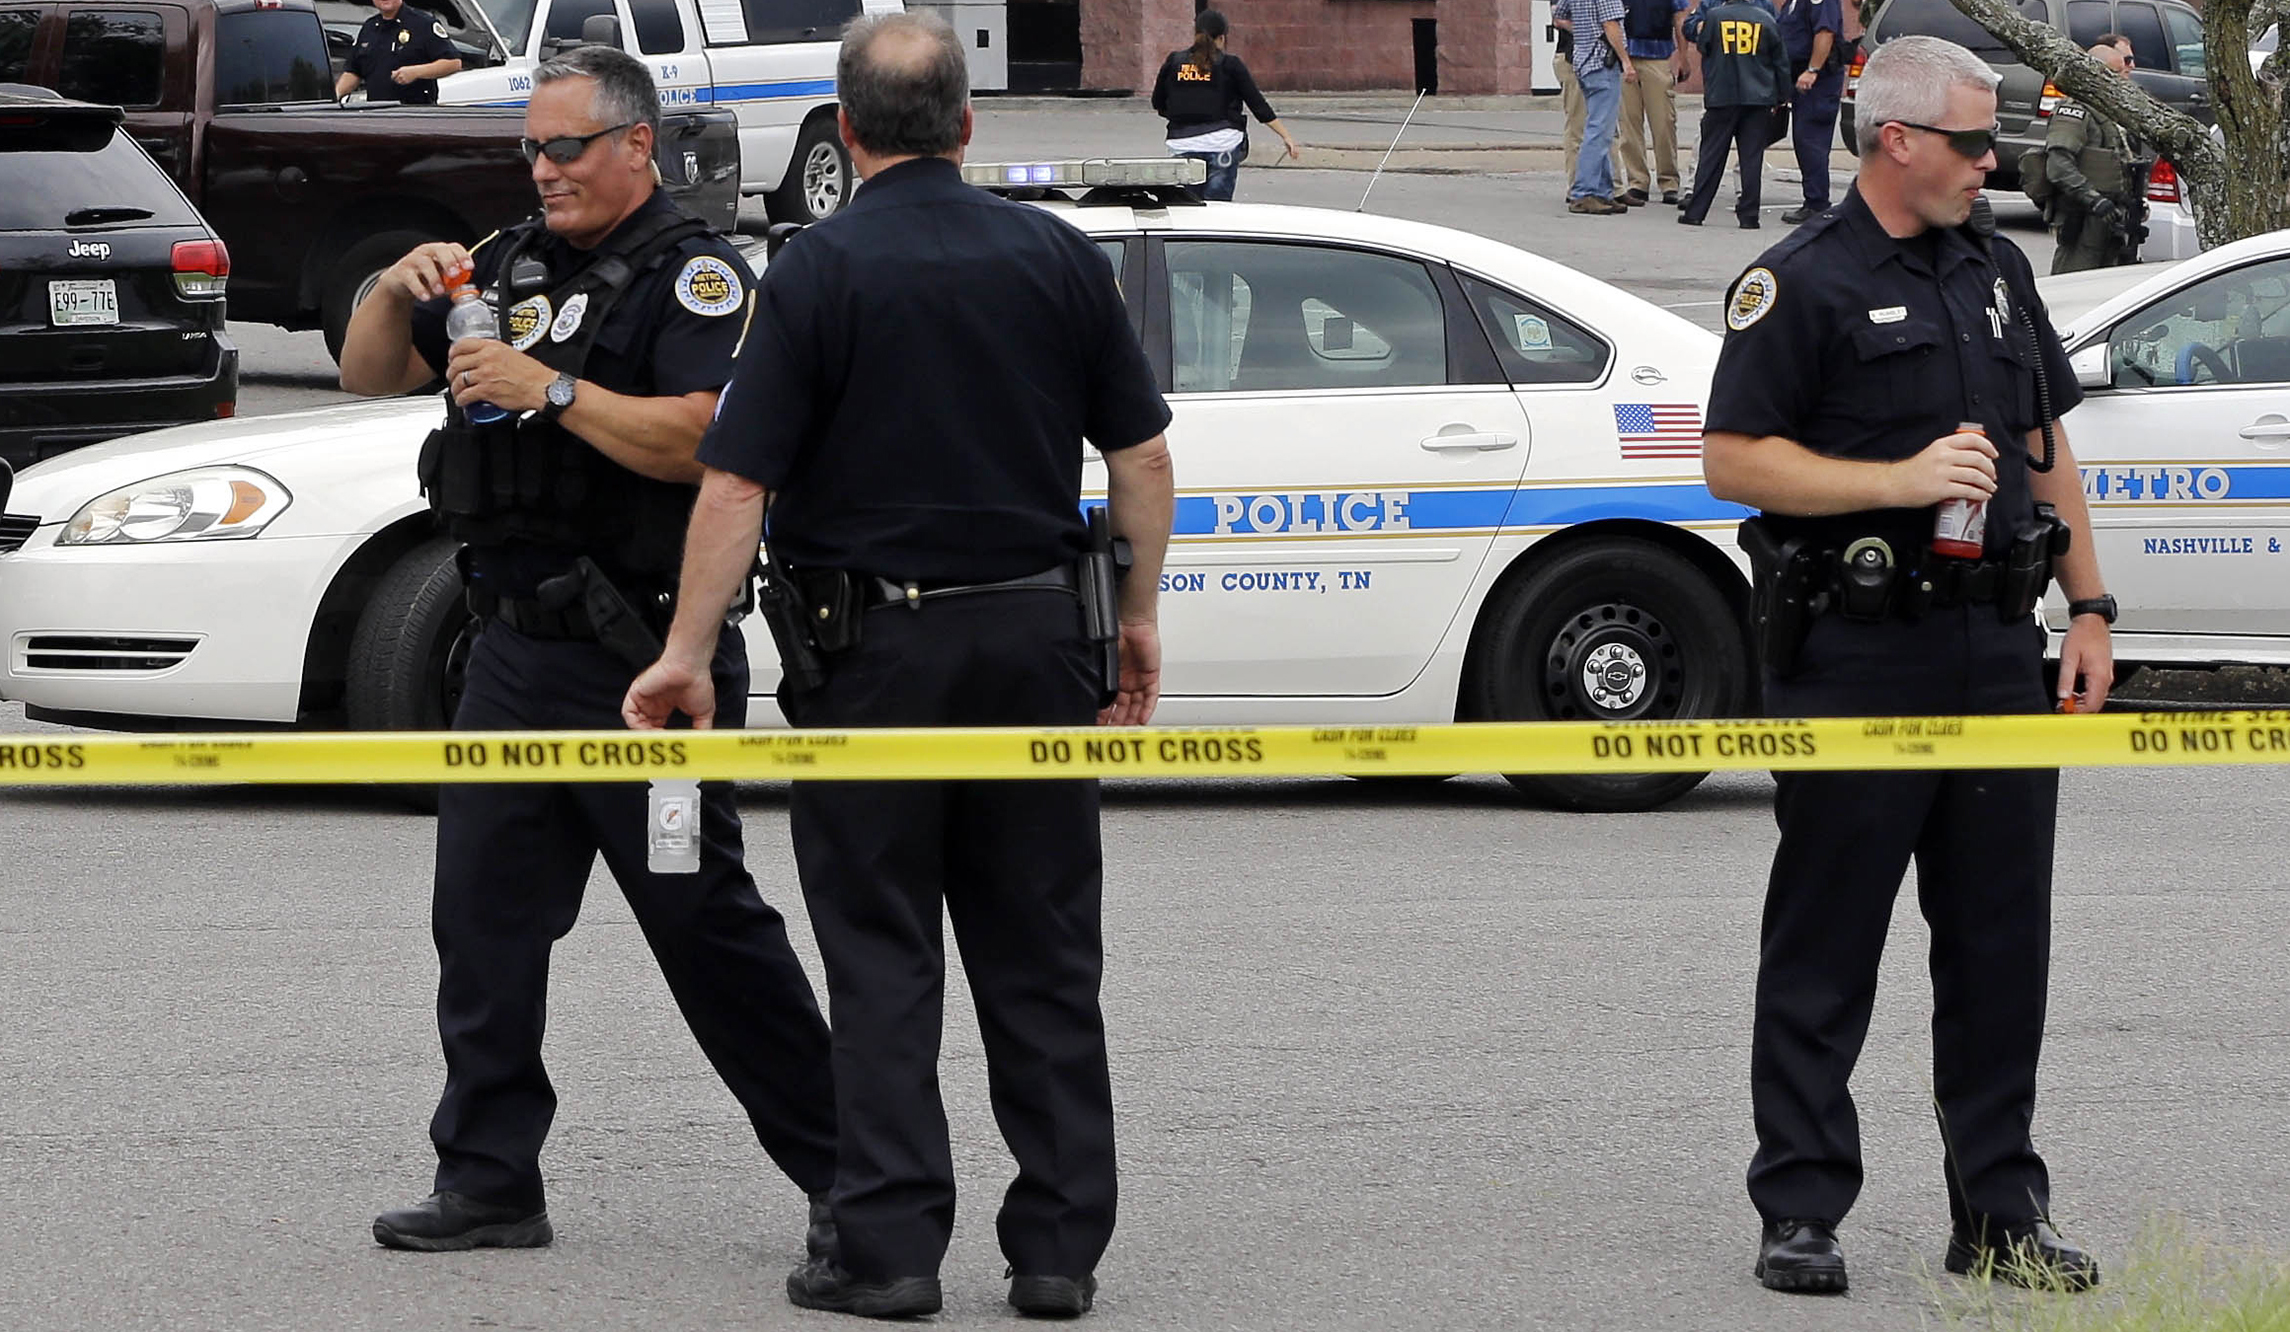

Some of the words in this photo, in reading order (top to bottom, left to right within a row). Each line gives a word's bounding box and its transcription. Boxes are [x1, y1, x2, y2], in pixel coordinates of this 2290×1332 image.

[1720, 21, 1761, 55] FBI
[660, 65, 679, 79] K-9
[508, 76, 531, 91] 1062
[2058, 107, 2085, 119] POLICE
[68, 240, 111, 260] Jeep
[691, 281, 729, 295] POLICE
[55, 291, 115, 312] E99-77E
[1213, 492, 1410, 534] POLICE
[2143, 537, 2253, 554] NASHVILLE
[2268, 536, 2281, 553] &
[1221, 571, 1326, 594] COUNTY,
[1338, 571, 1371, 590] TN
[1031, 740, 1071, 763] DO
[1086, 740, 1145, 763] NOT
[1160, 739, 1263, 763] CROSS
[1593, 735, 1633, 758] DO
[1646, 735, 1703, 757] NOT
[1716, 733, 1816, 757] CROSS
[2130, 729, 2168, 752] DO
[2181, 729, 2235, 752] NOT
[444, 743, 487, 766] DO
[503, 743, 564, 766] NOT
[580, 742, 687, 766] CROSS
